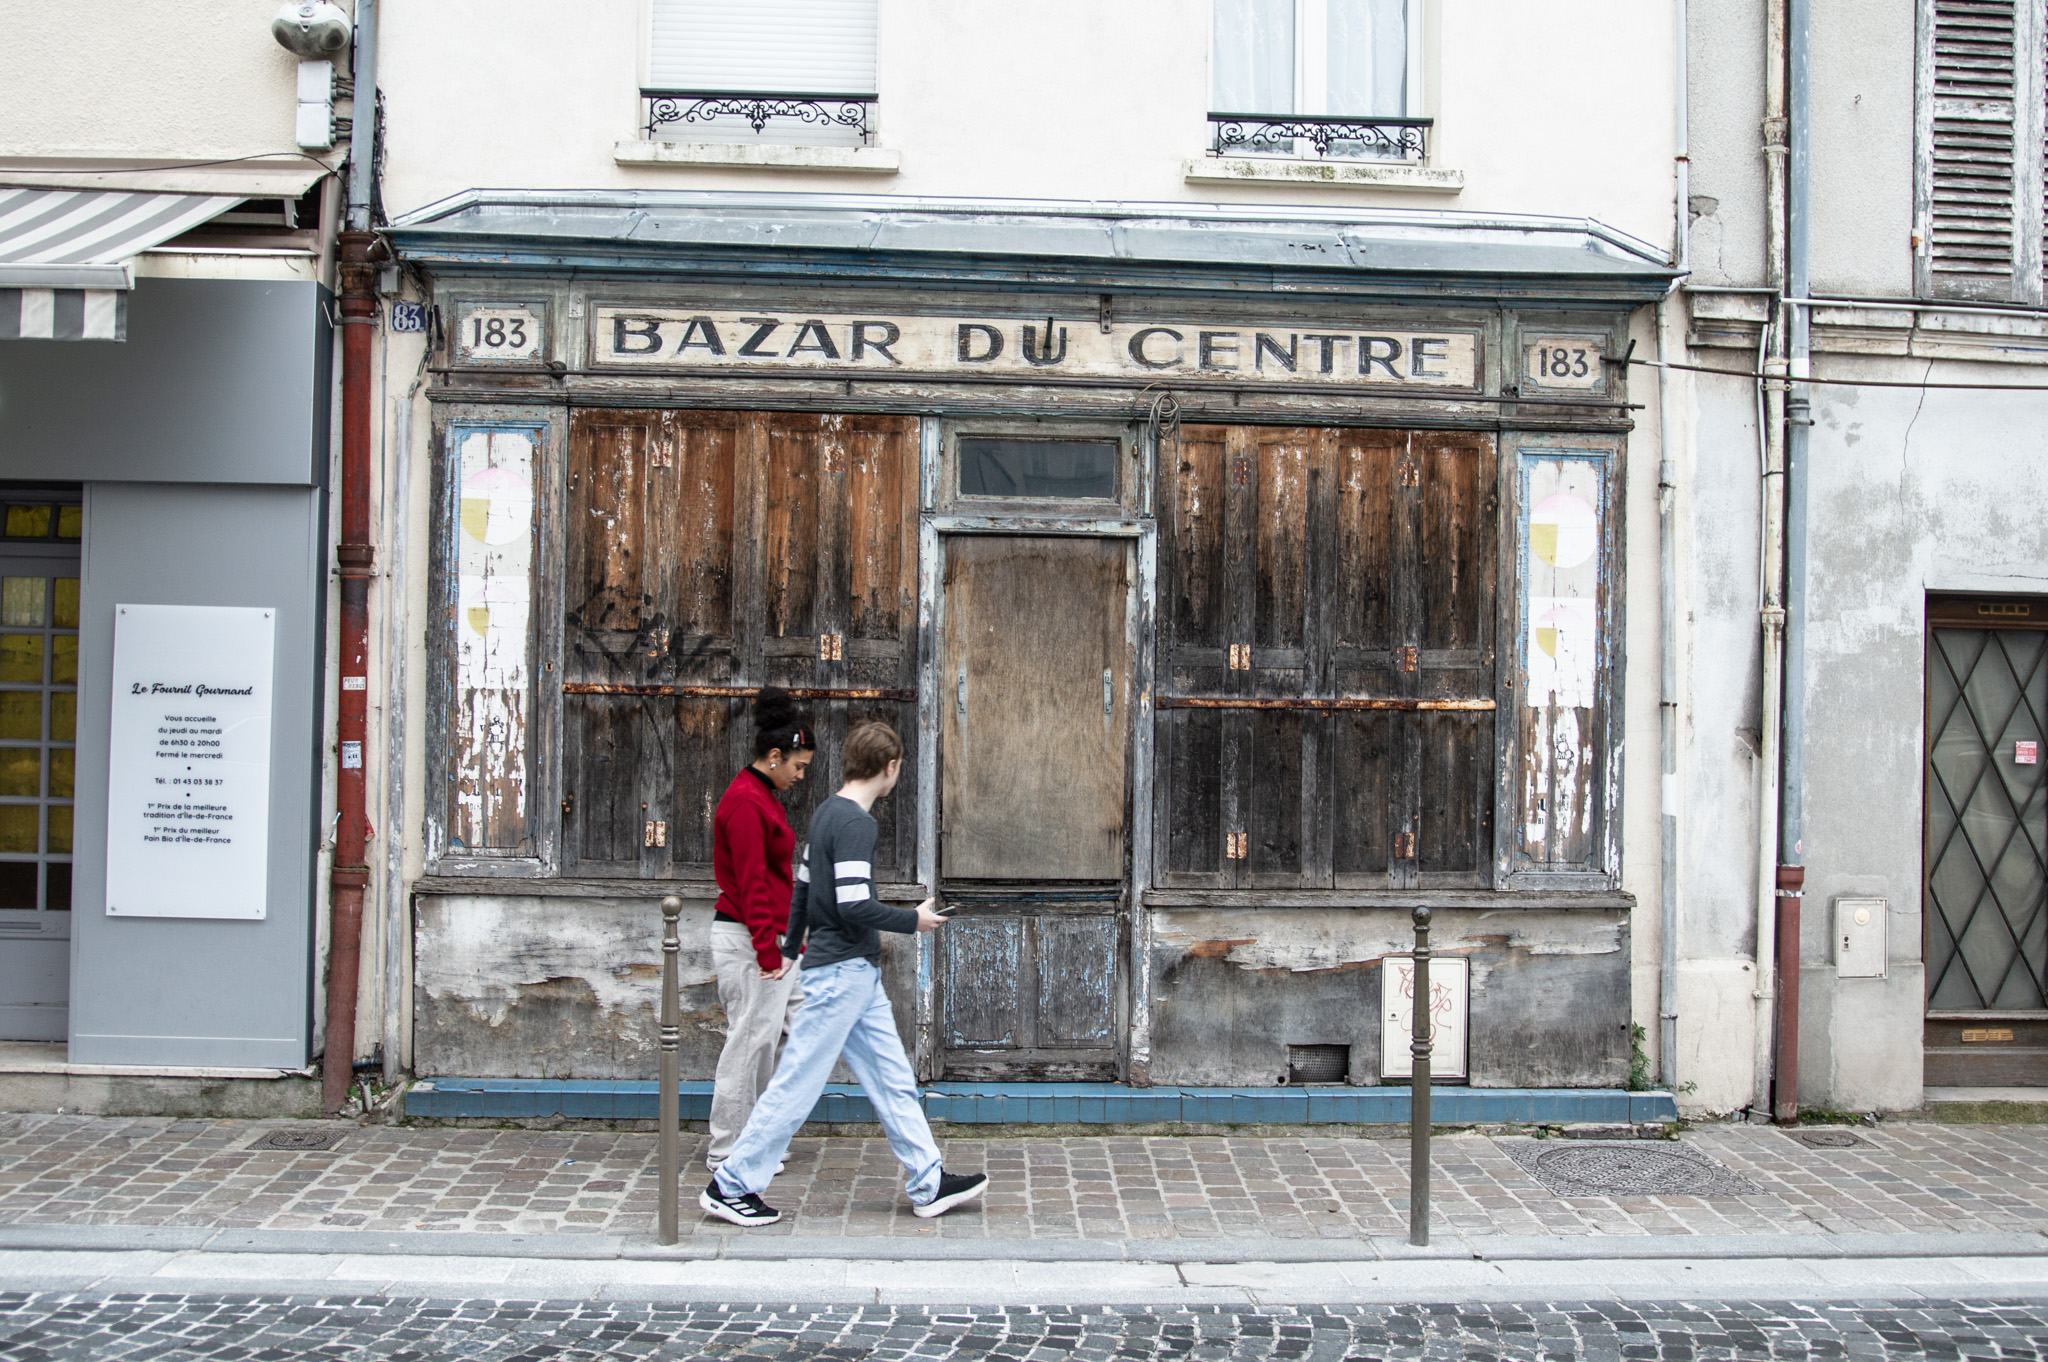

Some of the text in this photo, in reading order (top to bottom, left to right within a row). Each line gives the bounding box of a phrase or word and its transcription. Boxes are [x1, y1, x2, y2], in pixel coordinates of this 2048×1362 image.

[394, 305, 421, 331] 83
[473, 317, 527, 349] 183
[612, 314, 1451, 379] BAZAR DU CENTRE
[1538, 346, 1590, 378] 183
[131, 682, 253, 698] Le Fournil Gourmand
[169, 727, 187, 735] jeudi
[184, 715, 217, 723] accueille
